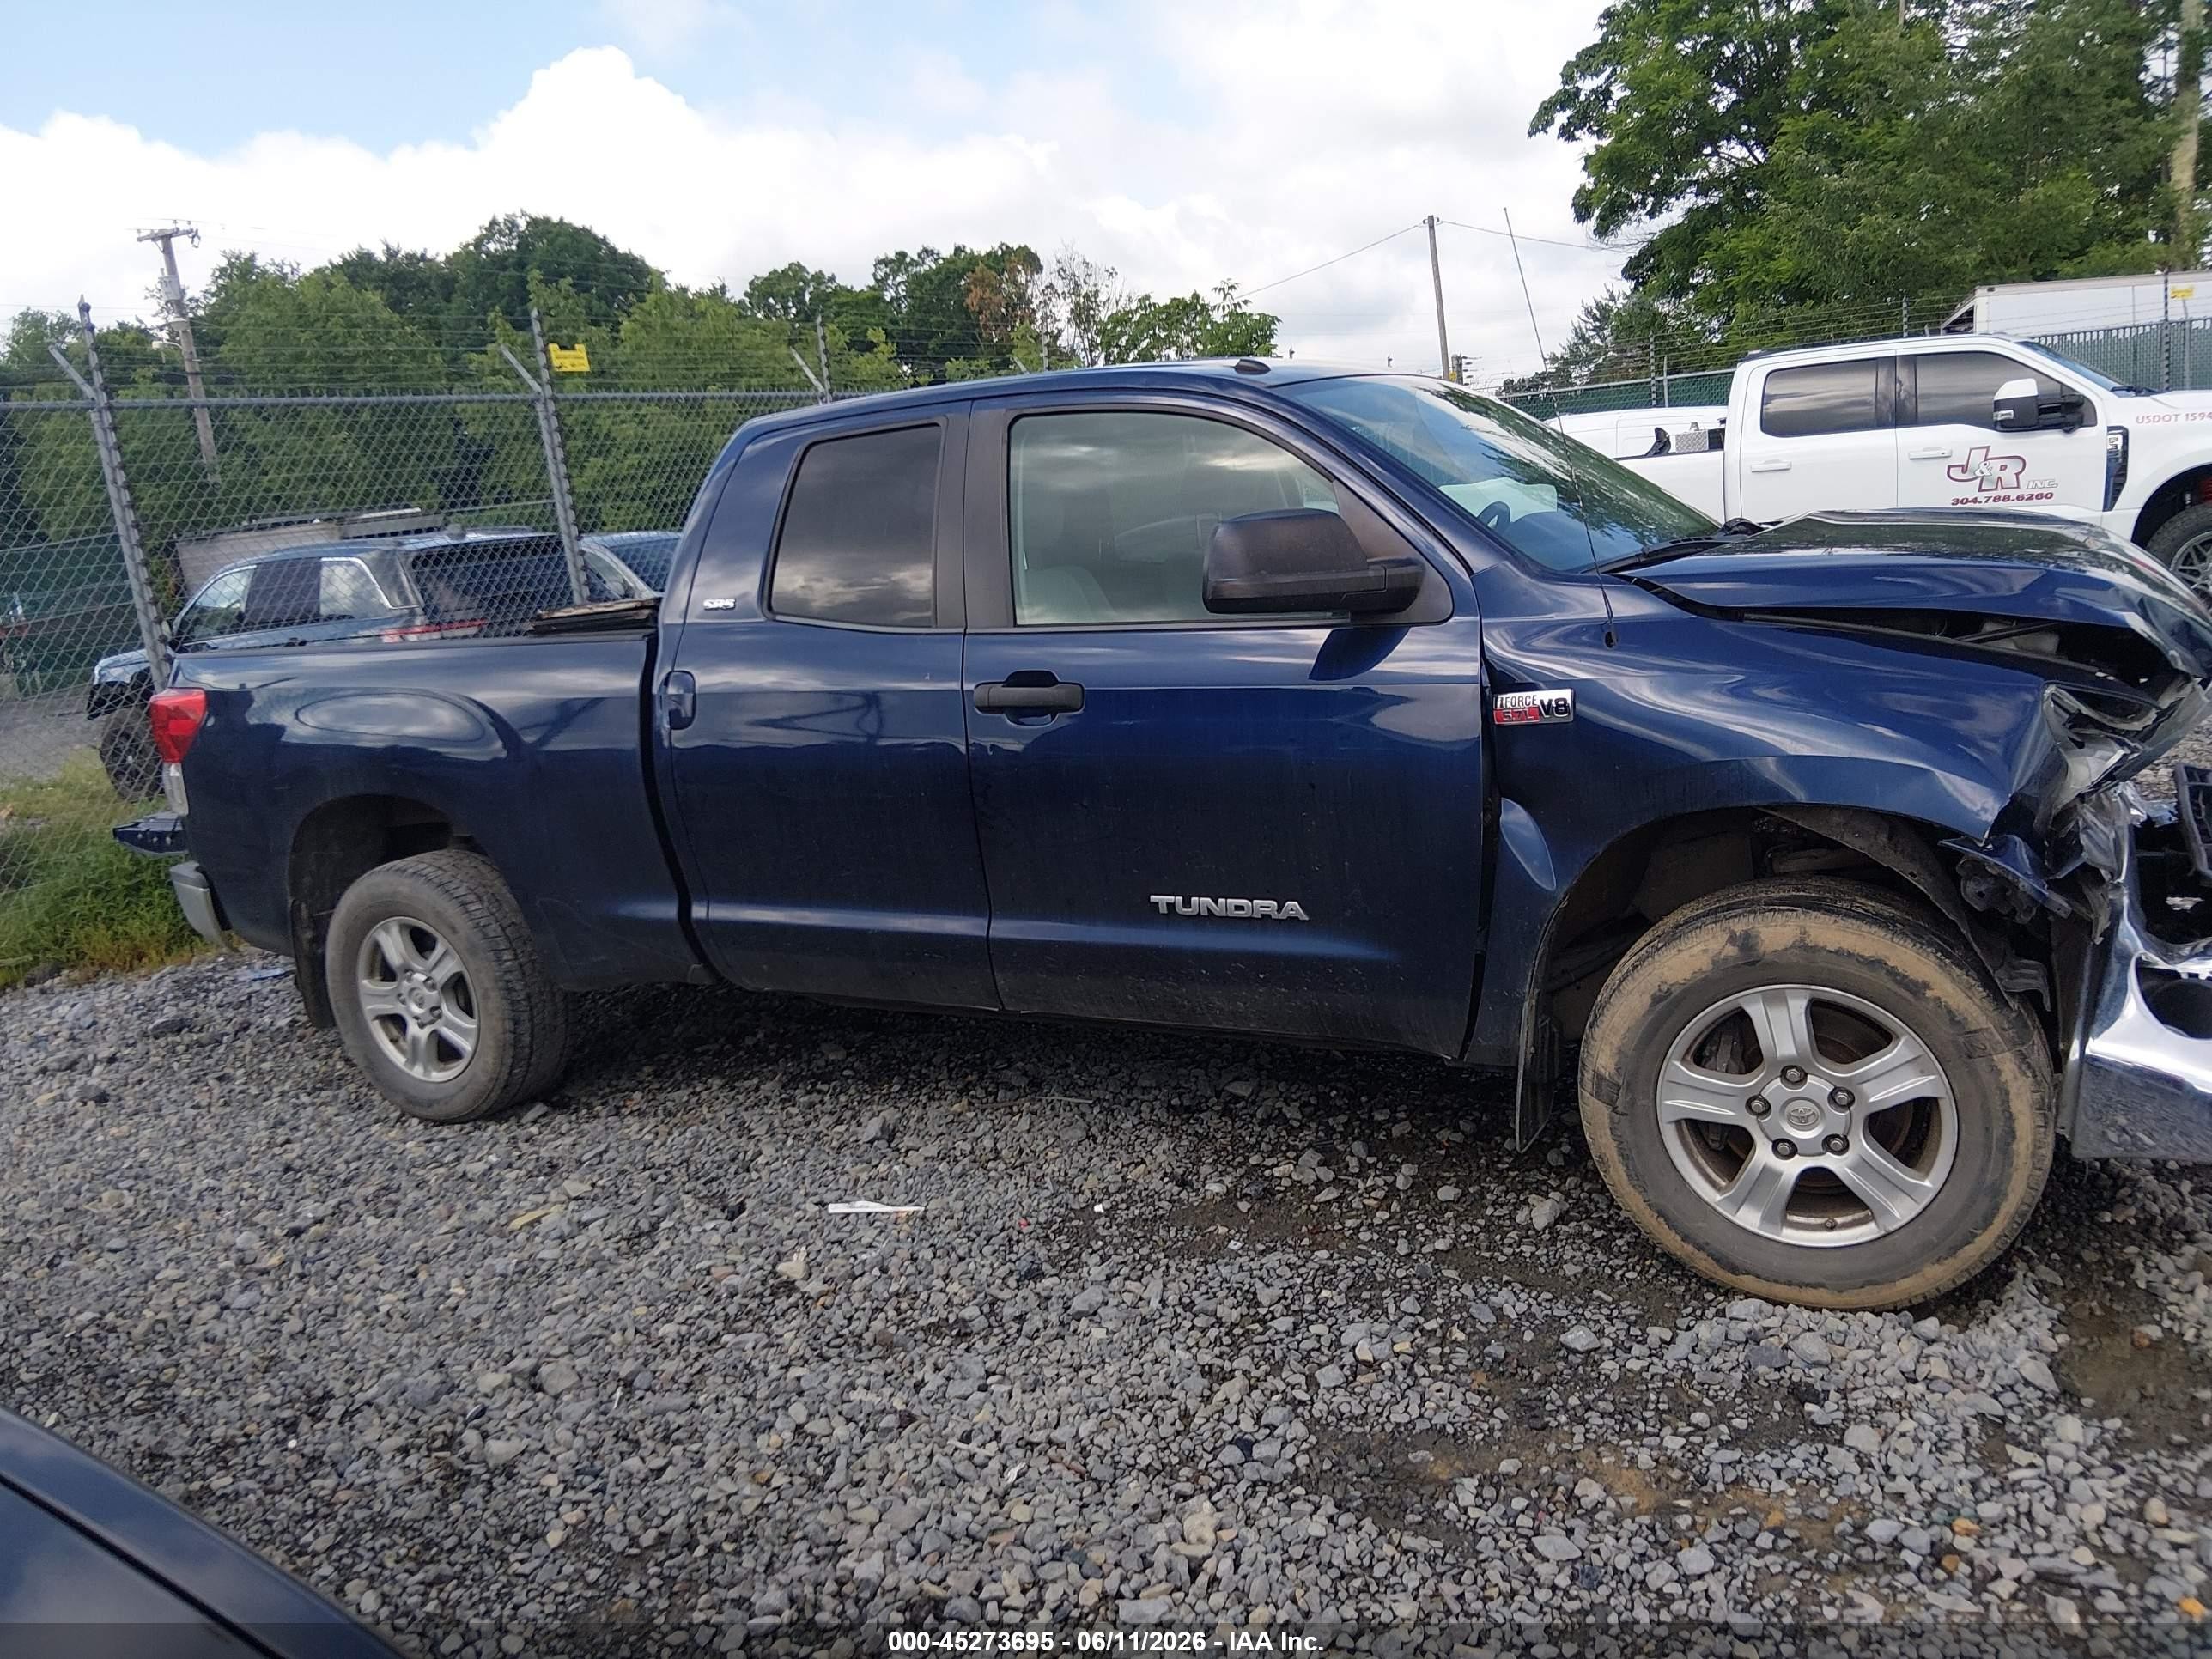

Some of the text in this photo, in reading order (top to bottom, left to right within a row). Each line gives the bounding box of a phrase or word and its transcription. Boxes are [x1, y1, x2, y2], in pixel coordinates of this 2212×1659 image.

[2136, 414, 2180, 424] USDOT
[1947, 446, 2059, 492] J&R INC.
[1951, 492, 2054, 506] 304.788.6260
[1503, 708, 1534, 720] 5.7L
[1540, 697, 1570, 718] V8
[1150, 895, 1310, 921] TUNDRA
